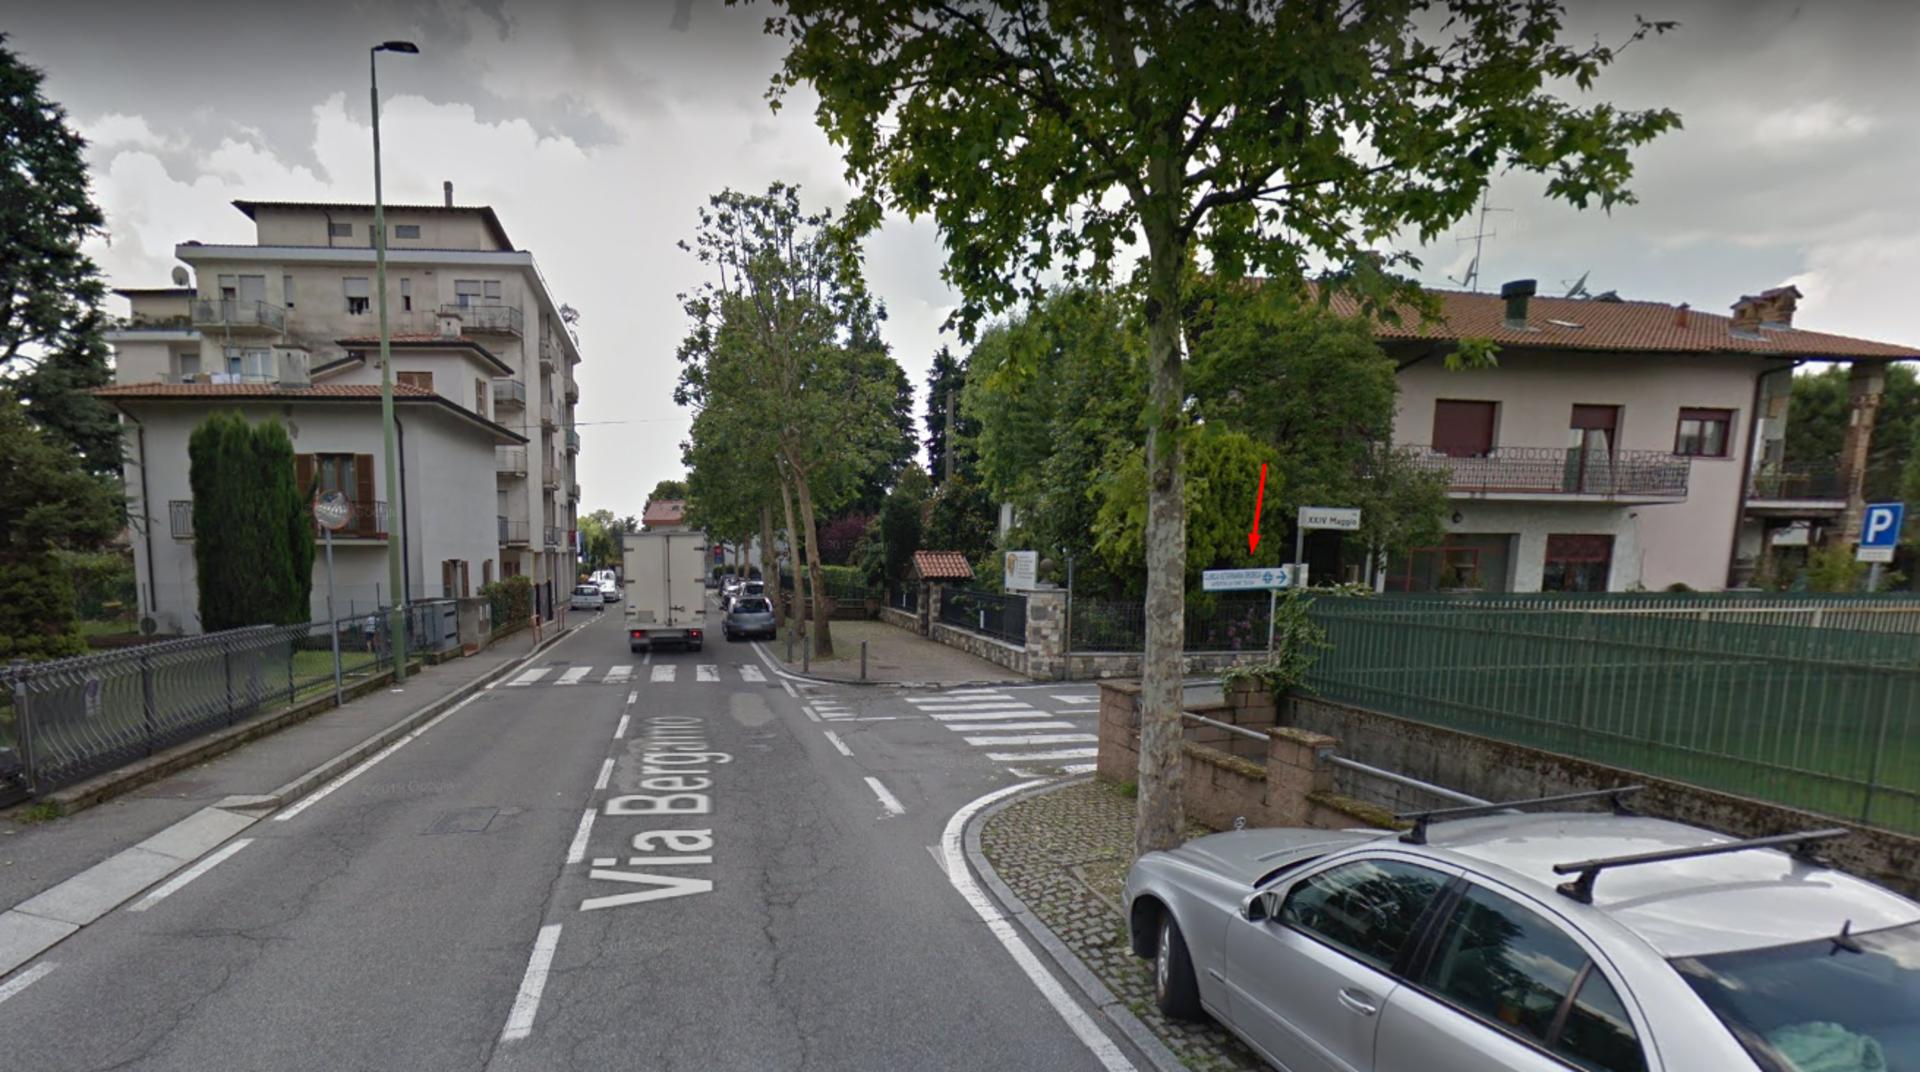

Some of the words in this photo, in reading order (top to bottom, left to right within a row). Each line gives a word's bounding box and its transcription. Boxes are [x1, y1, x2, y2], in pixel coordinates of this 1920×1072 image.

[1307, 516, 1327, 524] XXIV
[1329, 516, 1357, 527] Maggio
[1866, 508, 1893, 543] P
[579, 828, 713, 911] Via
